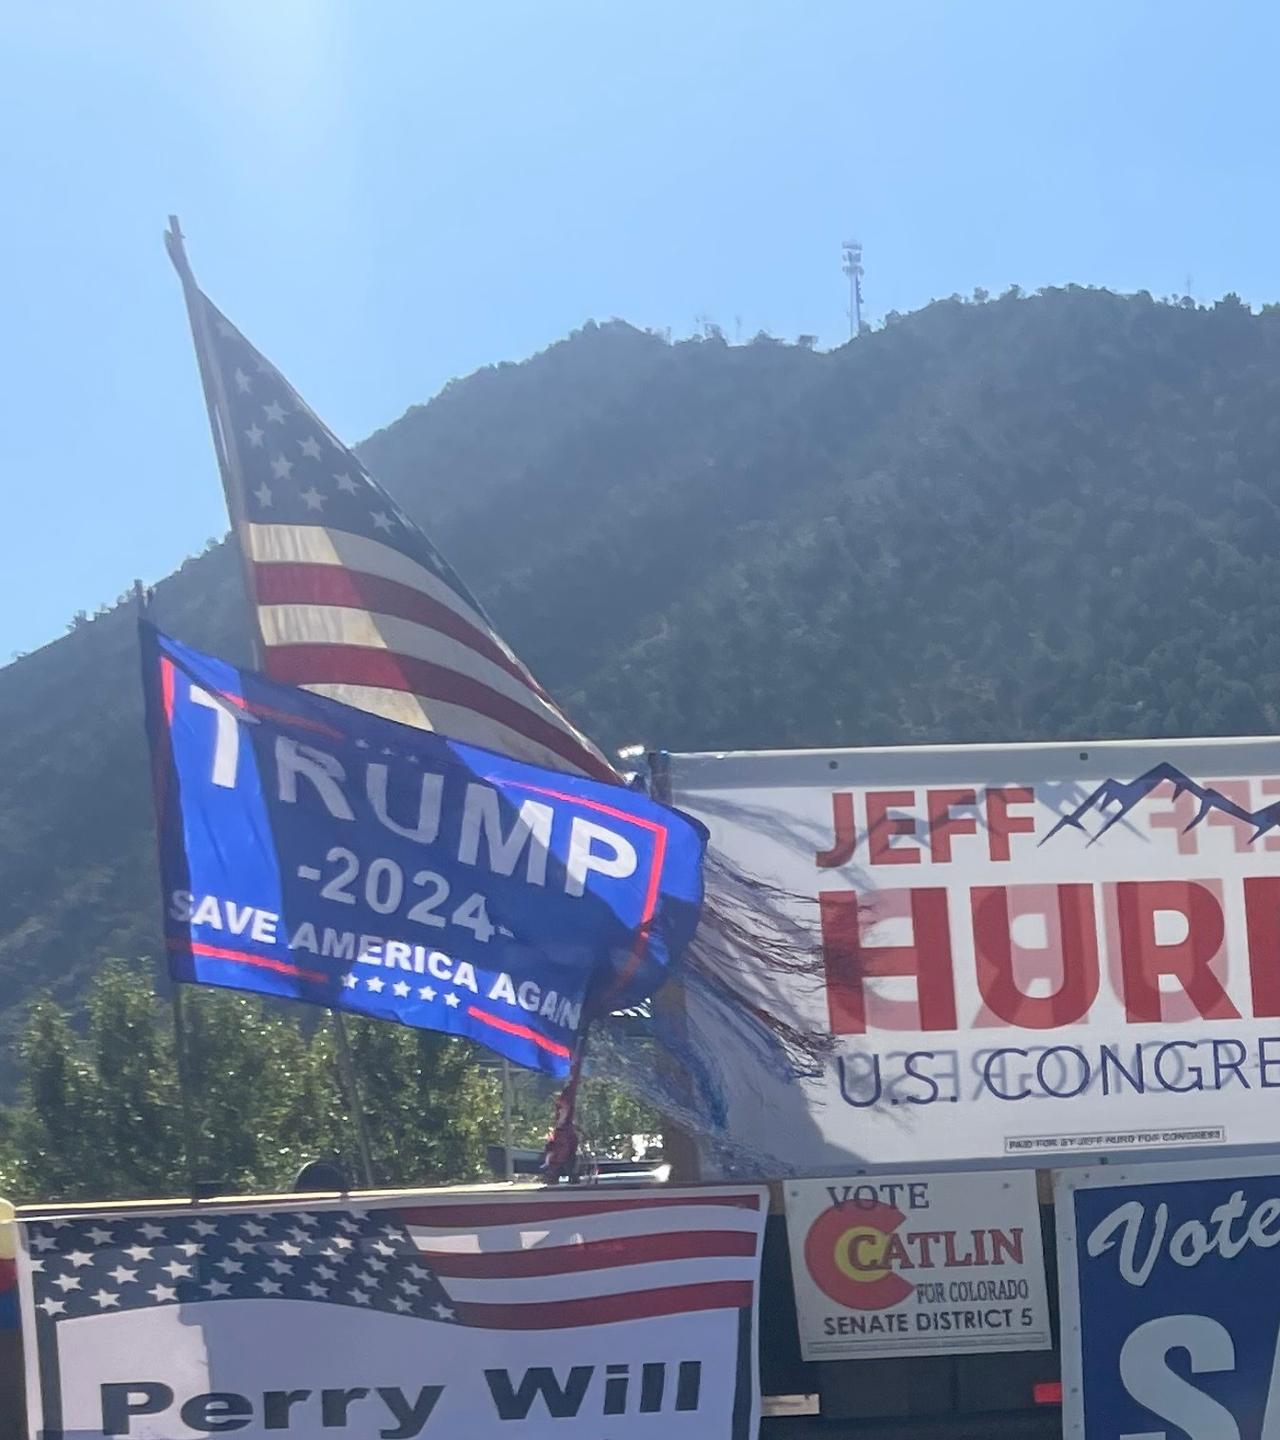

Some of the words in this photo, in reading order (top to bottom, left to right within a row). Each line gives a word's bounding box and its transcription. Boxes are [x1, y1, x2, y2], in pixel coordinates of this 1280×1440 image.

[190, 684, 637, 897] TRUMP
[816, 787, 1035, 868] JEFF
[170, 890, 277, 944] SAVE
[290, 922, 478, 990] AMERICA
[490, 975, 582, 1030] AGAIN
[837, 1051, 957, 1108] U.S.
[826, 1183, 930, 1212] VOTE
[847, 1228, 1024, 1271] CATLIN
[916, 1283, 945, 1304] FOR
[950, 1279, 1029, 1302] COLORADO
[824, 1313, 908, 1335] SENATE
[917, 1309, 1012, 1331] DISTRICT
[1021, 1308, 1033, 1327] 5
[100, 1381, 445, 1440] Perry
[484, 1360, 702, 1420] Will
